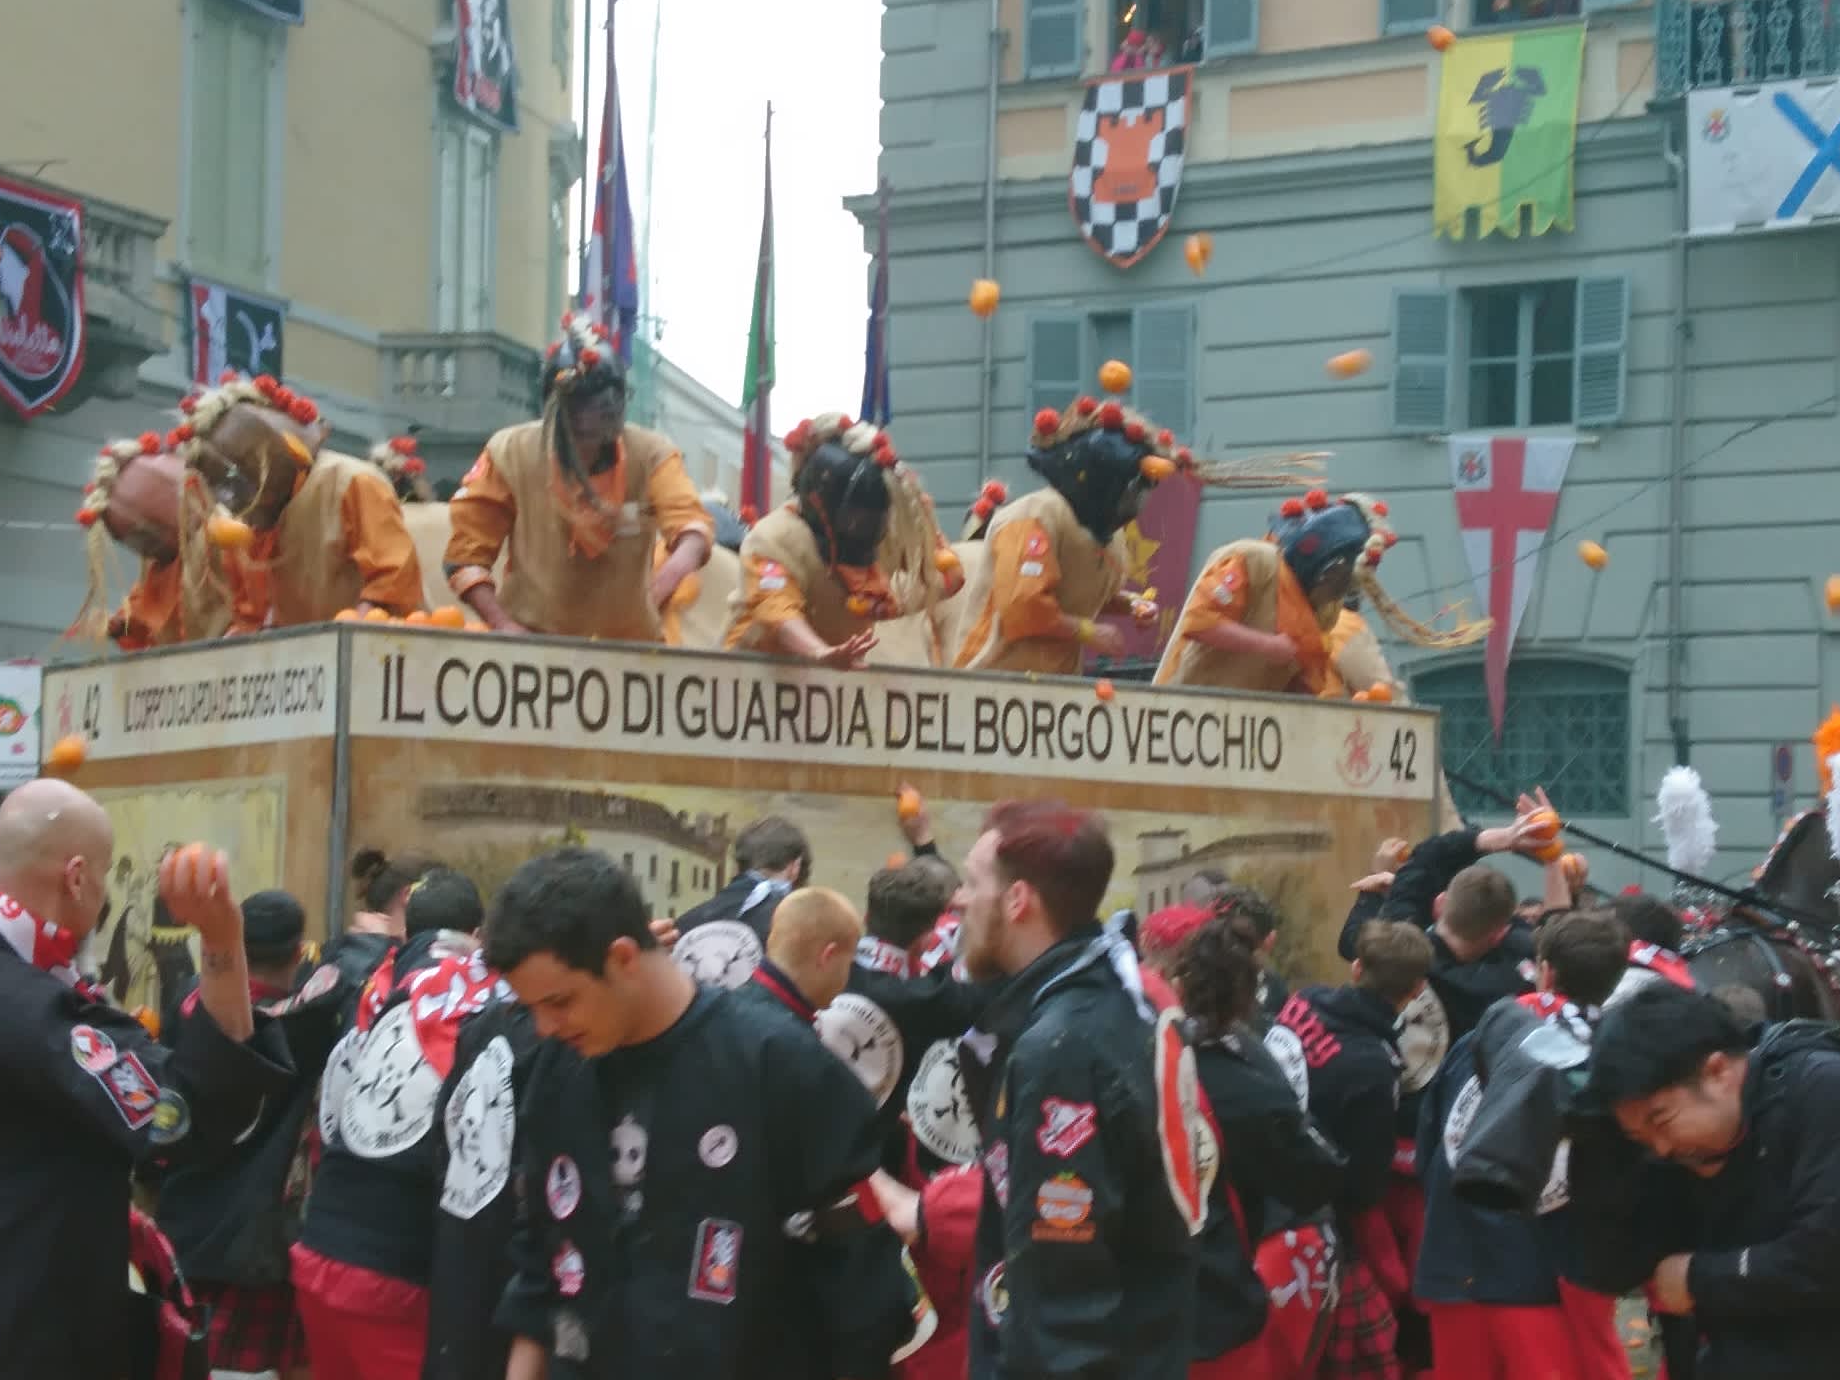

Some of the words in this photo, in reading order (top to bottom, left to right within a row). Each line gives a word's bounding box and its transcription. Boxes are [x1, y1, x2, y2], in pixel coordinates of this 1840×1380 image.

[381, 653, 425, 723] IL
[435, 658, 610, 733] CORPO
[622, 671, 665, 737] DI
[675, 675, 874, 749] GUARDIA
[884, 690, 965, 754] DEL
[973, 696, 1114, 762] BORGO
[1121, 705, 1284, 772] VECCHIO
[1388, 728, 1418, 783] 42
